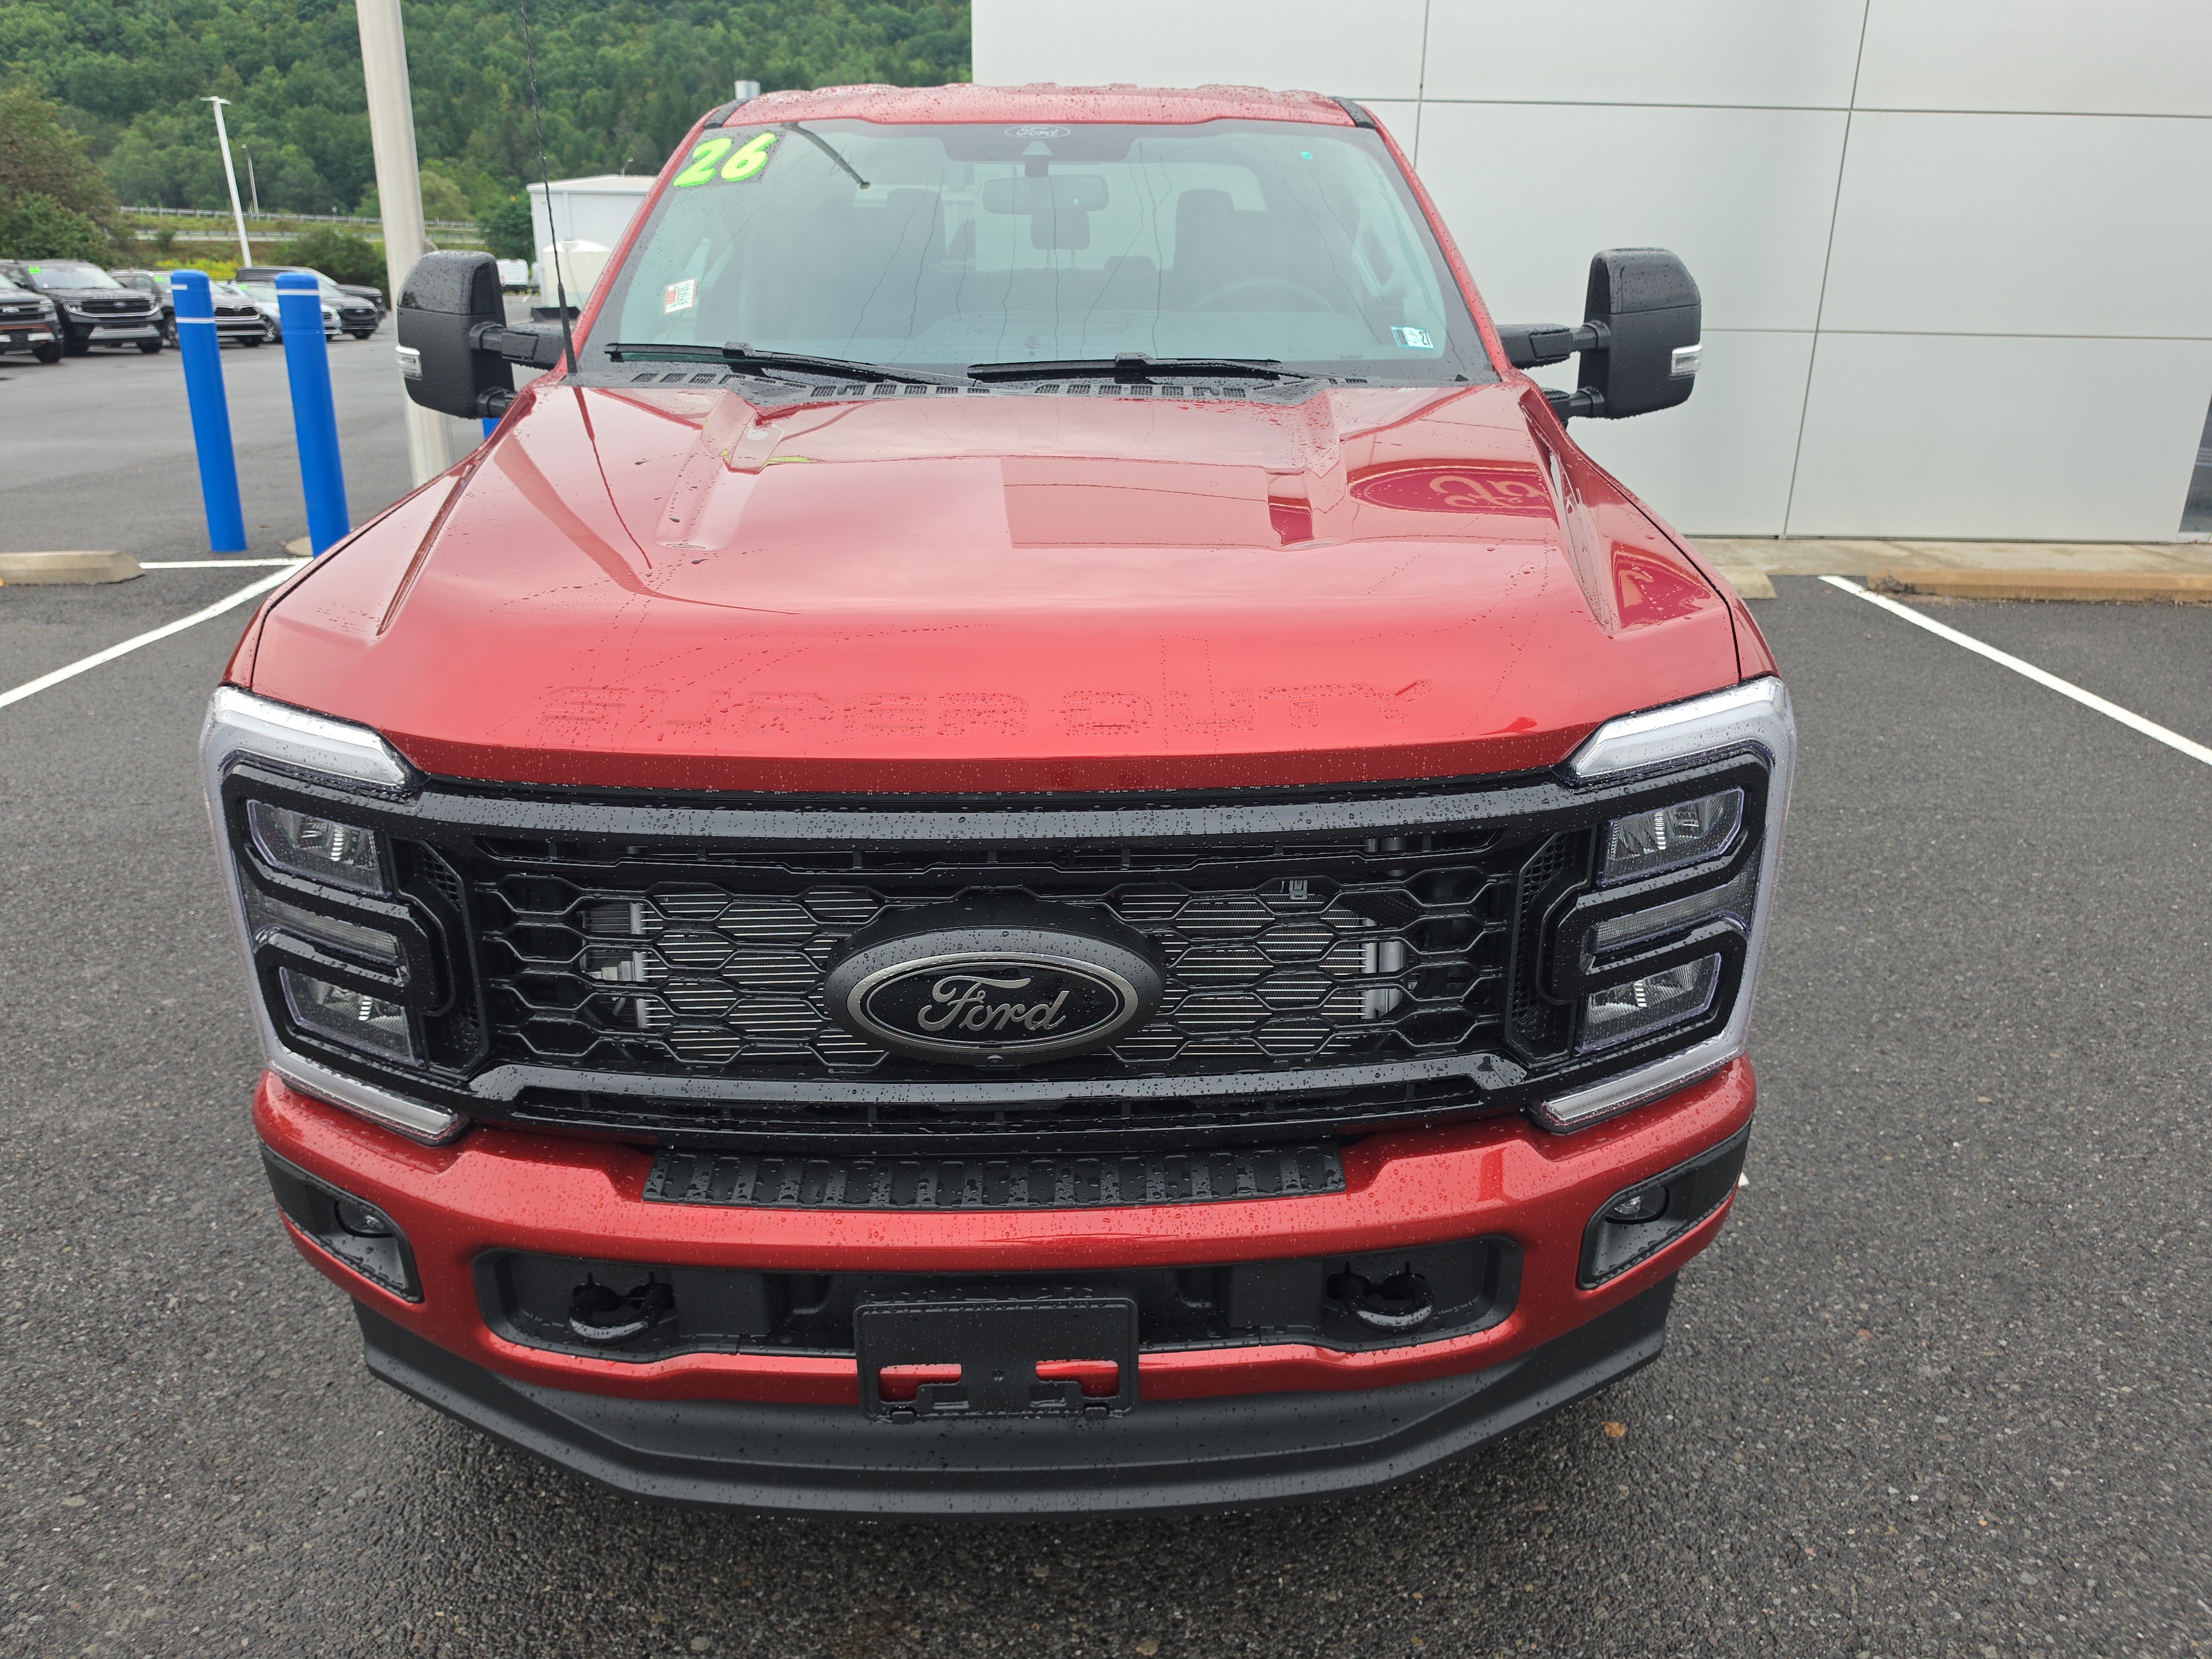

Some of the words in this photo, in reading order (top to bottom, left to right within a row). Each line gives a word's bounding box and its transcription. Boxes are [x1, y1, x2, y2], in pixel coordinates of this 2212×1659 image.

[1016, 126, 1059, 136] Ford
[673, 132, 776, 187] 26
[542, 685, 1030, 737] SUPER
[1063, 679, 1434, 736] DUTY
[917, 975, 1069, 1031] Ford
